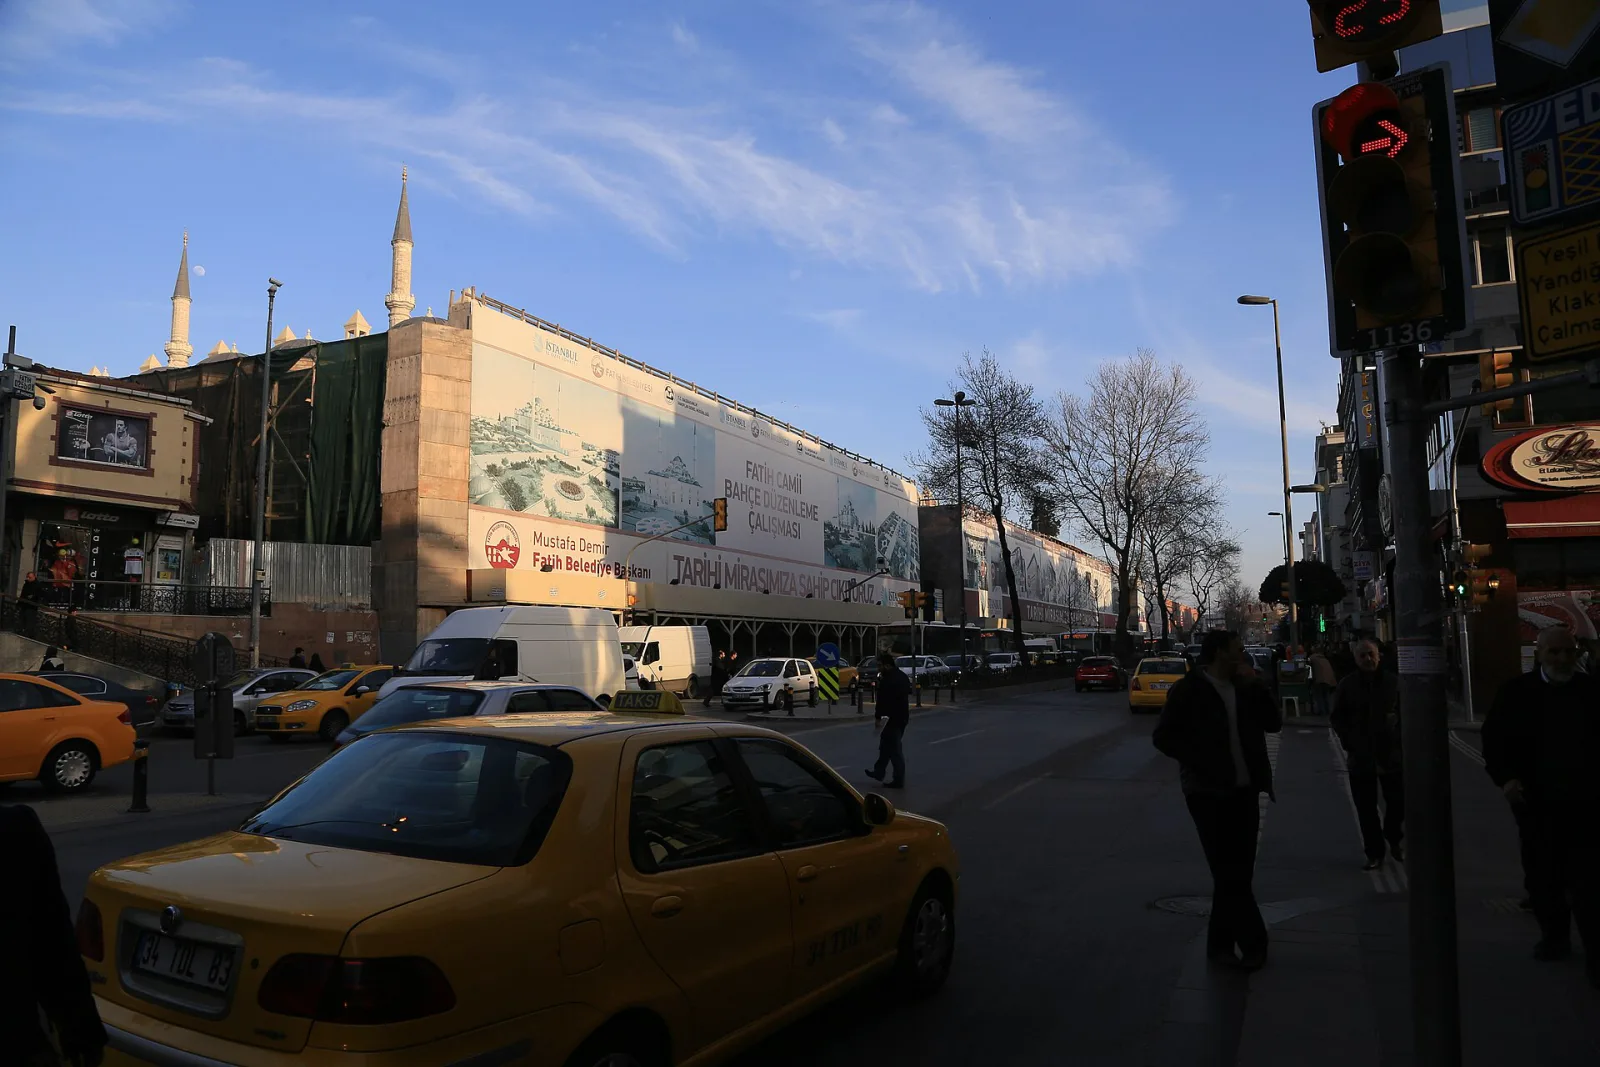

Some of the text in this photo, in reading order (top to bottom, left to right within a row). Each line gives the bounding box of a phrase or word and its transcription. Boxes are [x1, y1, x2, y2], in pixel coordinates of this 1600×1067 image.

[1539, 236, 1588, 265] Yeşil
[1367, 320, 1432, 349] 1136
[745, 460, 802, 495] FATİH CAMİİ
[724, 478, 819, 522] BAHÇE DÜZENLEME
[748, 510, 802, 540] ÇALIŞMASI
[533, 530, 609, 555] Mustafa Demir
[89, 535, 100, 600] adidas
[532, 552, 651, 580] Fatih Belediye Başkanı
[673, 552, 722, 589] TARİHİ
[724, 557, 798, 597] MİRASIMIZA
[799, 570, 829, 600] SAHİP
[619, 693, 660, 708] TAKSİ
[142, 935, 161, 967] 34
